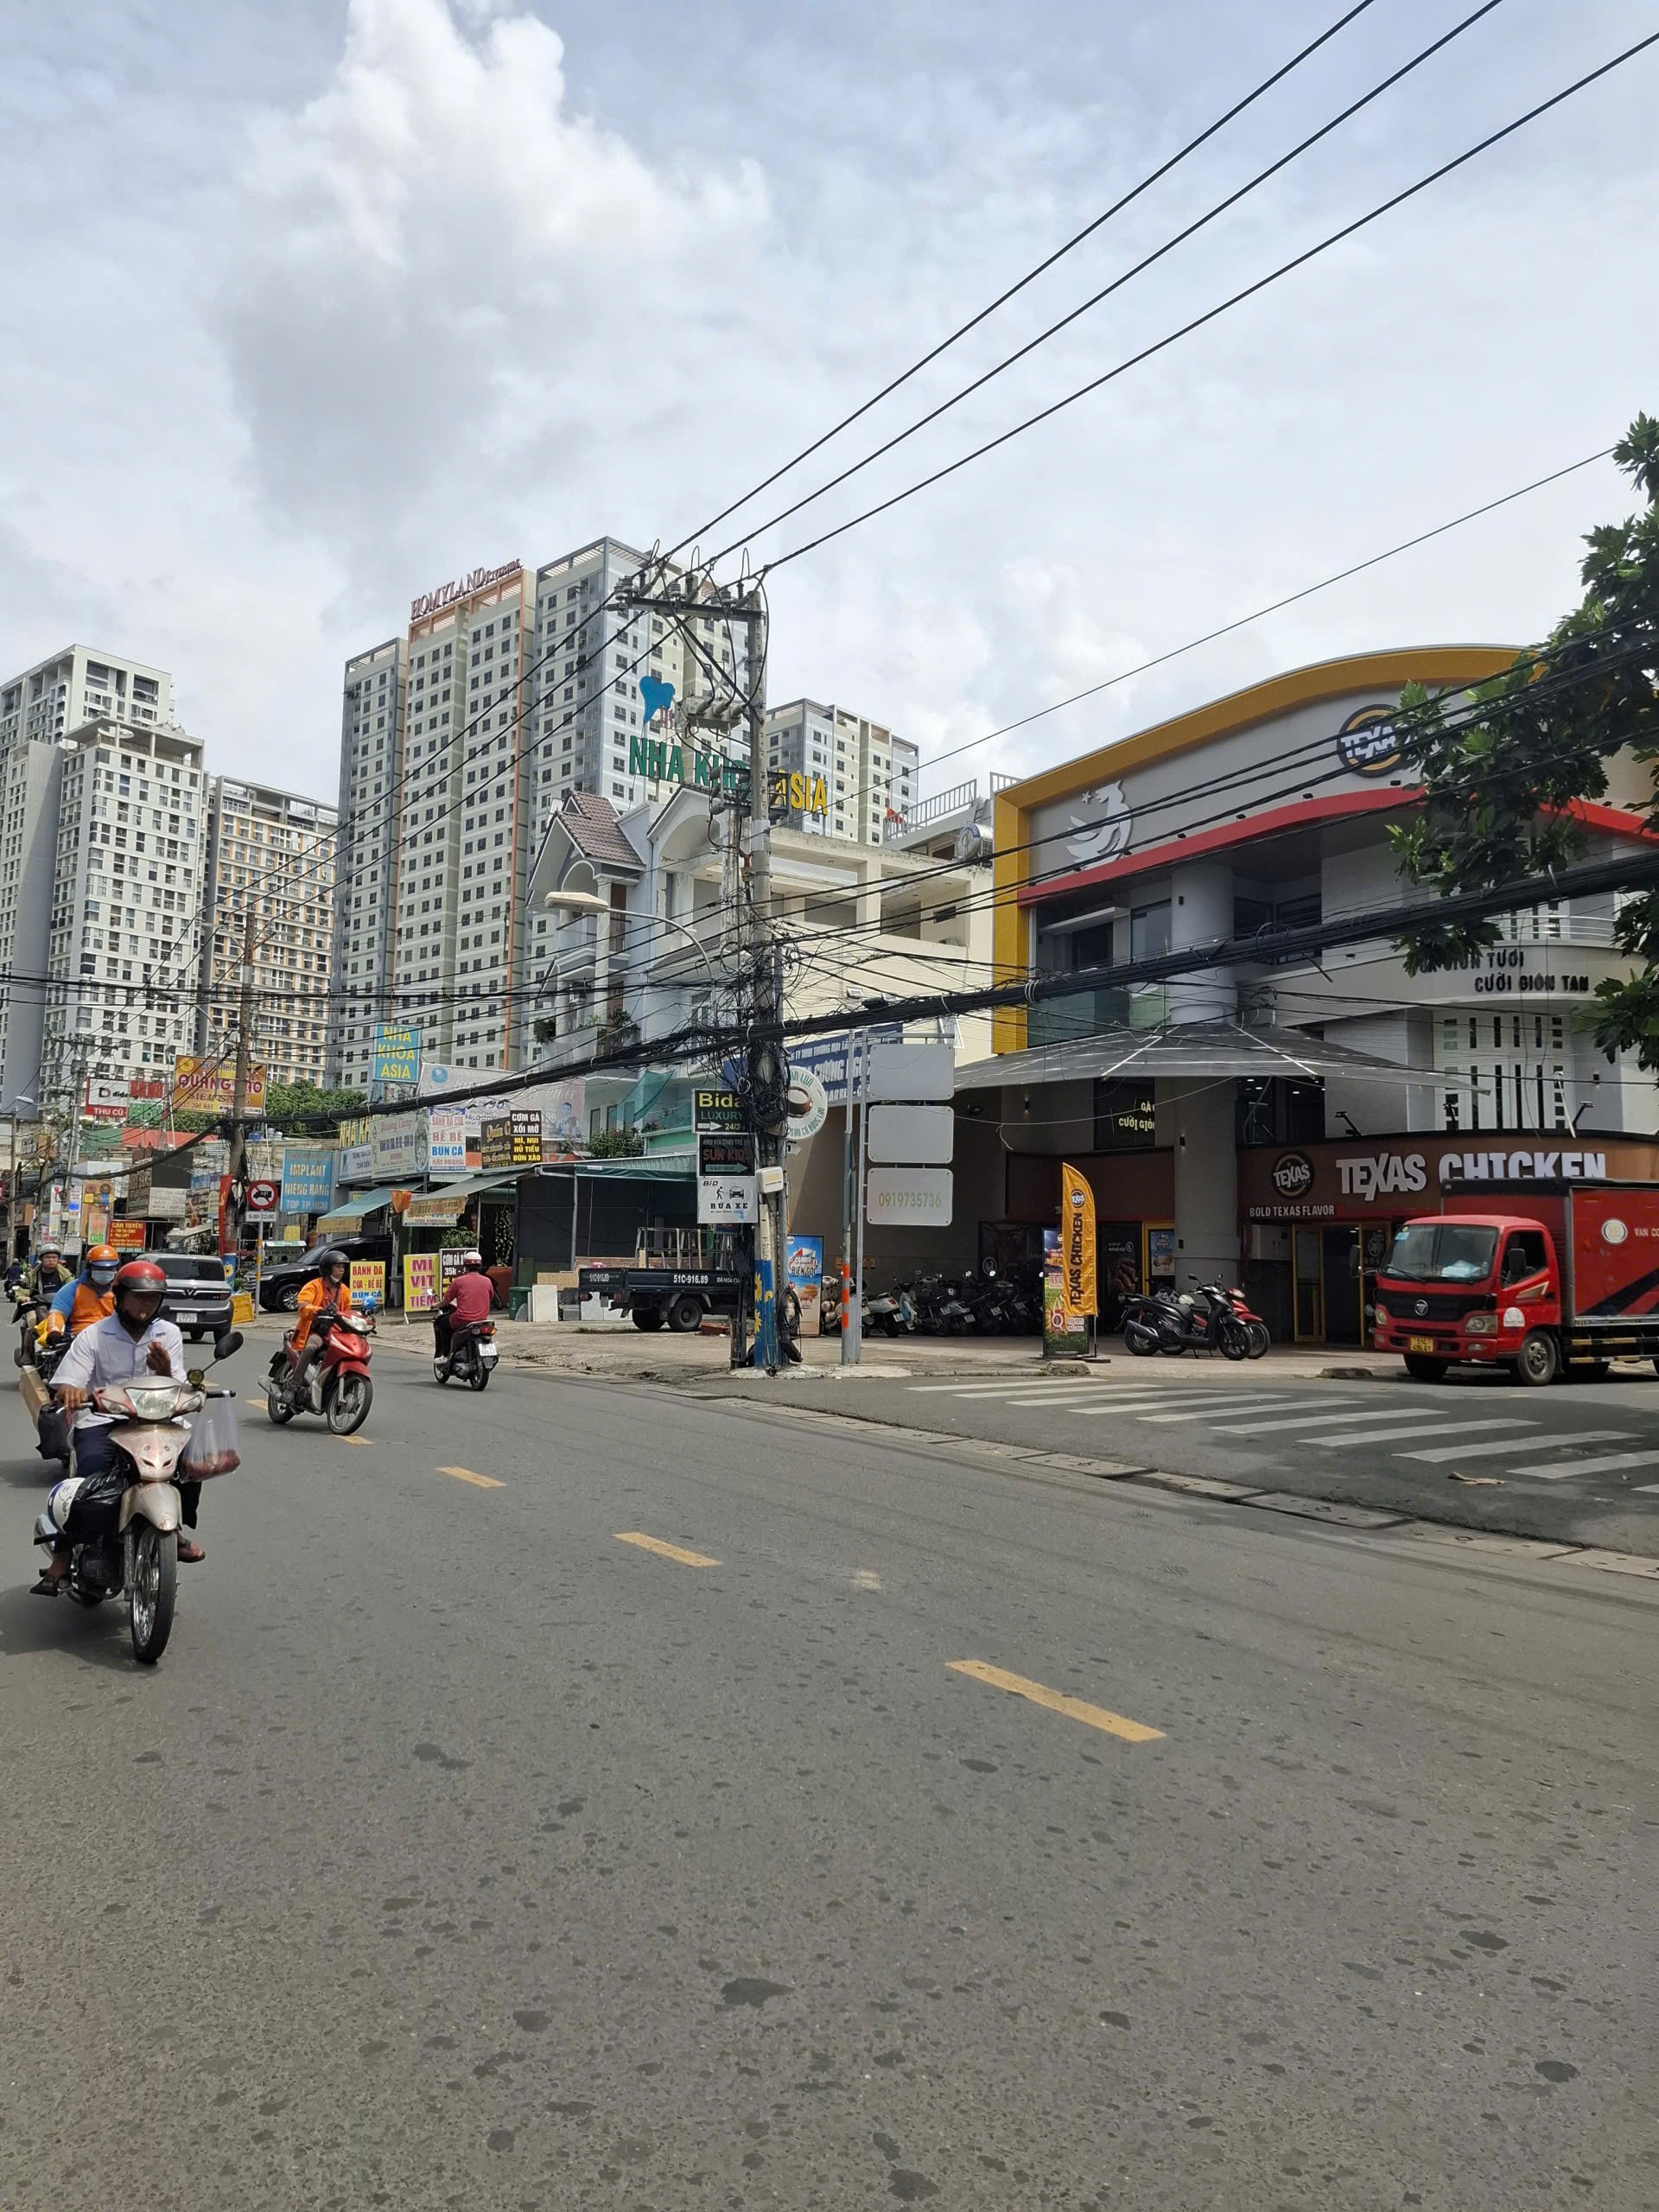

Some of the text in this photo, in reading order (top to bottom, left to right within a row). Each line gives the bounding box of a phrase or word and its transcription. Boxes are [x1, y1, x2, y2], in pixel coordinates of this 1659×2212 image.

[1341, 725, 1397, 760] TEXA
[629, 734, 684, 784] NHA
[1474, 970, 1513, 993] CƯỜI
[1561, 975, 1590, 992] TAN
[383, 1026, 412, 1043] NHA
[377, 1043, 416, 1061] KHOA
[380, 1063, 411, 1079] ASIA
[93, 1107, 111, 1116] THU
[1141, 1100, 1152, 1113] GÀ
[512, 1113, 529, 1122] CƠM
[530, 1111, 540, 1122] GÀ
[700, 1110, 743, 1121] LUXURY
[513, 1122, 540, 1134] XỐI MỠ
[524, 1144, 540, 1153] TIẾU
[702, 1148, 726, 1161] SUN
[528, 1153, 541, 1161] XÀO
[289, 1163, 327, 1177] IMPLANT
[1273, 1163, 1311, 1188] TEXAS
[1335, 1151, 1606, 1202] TEXAS CHICKEN
[710, 1200, 732, 1210] RỬA
[879, 1192, 941, 1208] 0919735736
[1249, 1205, 1335, 1217] BOLD TEXAS FLAVOR
[1070, 1212, 1084, 1266] CHICKEN
[412, 1256, 434, 1273] MÌ
[444, 1267, 457, 1276] 35k
[353, 1279, 364, 1289] CUA
[410, 1274, 435, 1290] VỊT
[673, 1274, 709, 1284] 51C-916.89
[1069, 1266, 1084, 1307] TEXAS
